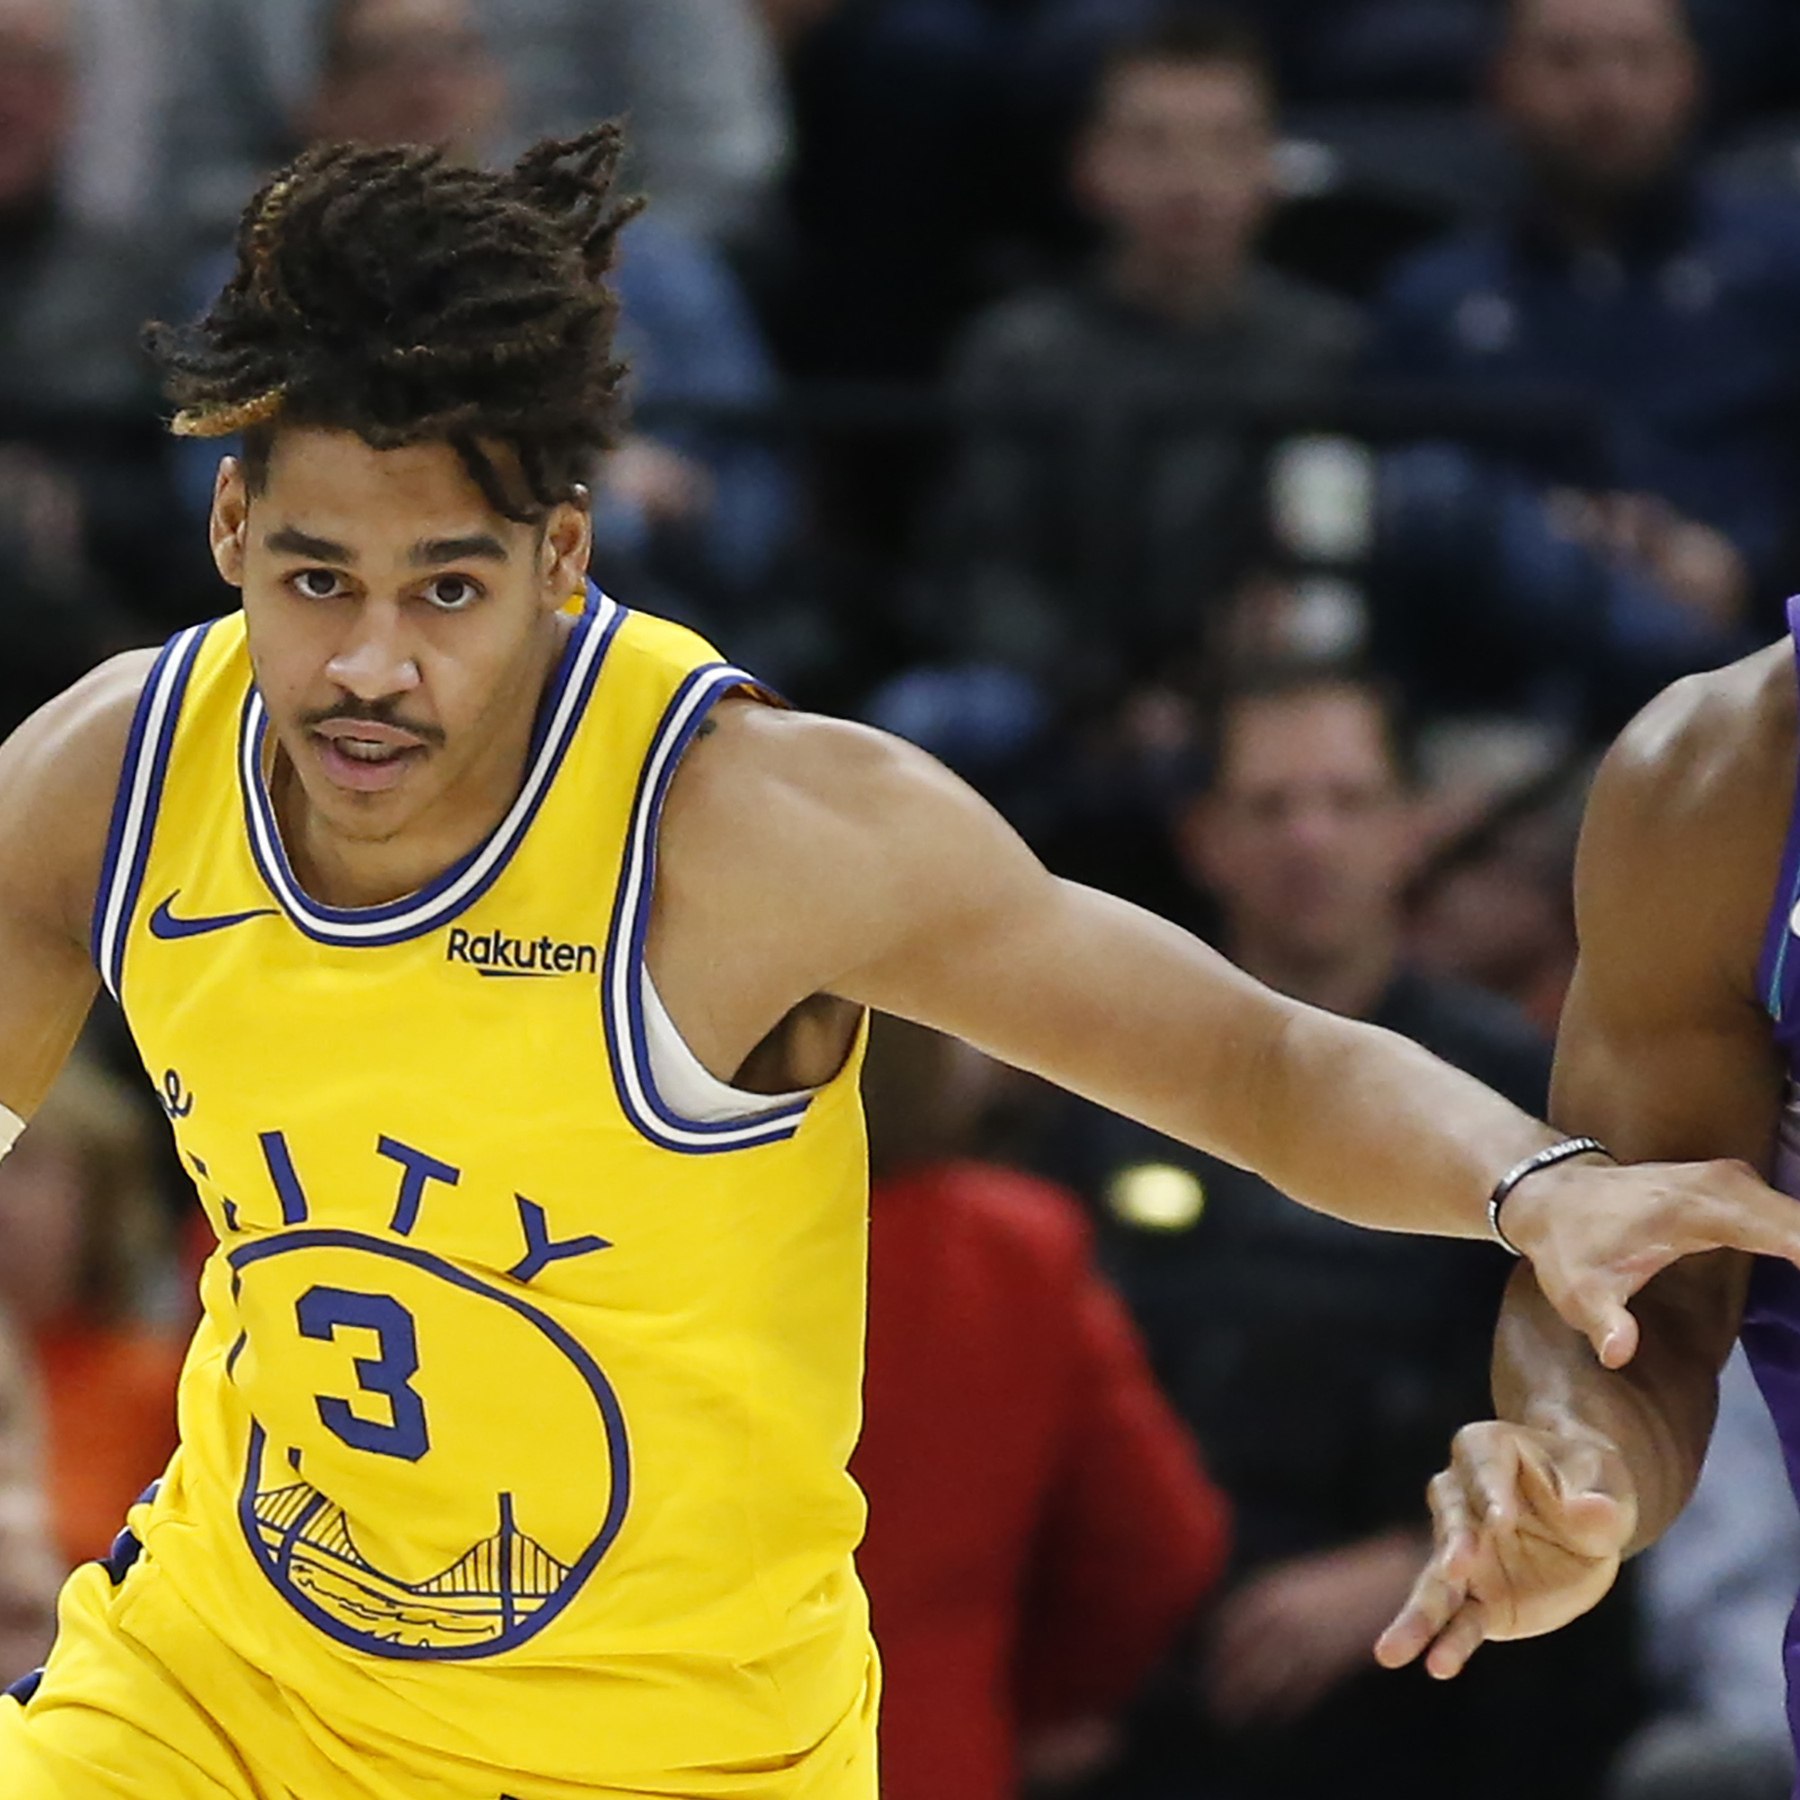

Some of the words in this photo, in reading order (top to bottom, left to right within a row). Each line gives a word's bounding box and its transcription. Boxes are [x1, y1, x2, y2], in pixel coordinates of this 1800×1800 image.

[446, 928, 596, 973] Rakuten
[187, 1130, 614, 1284] ITY
[295, 1284, 430, 1463] 3
